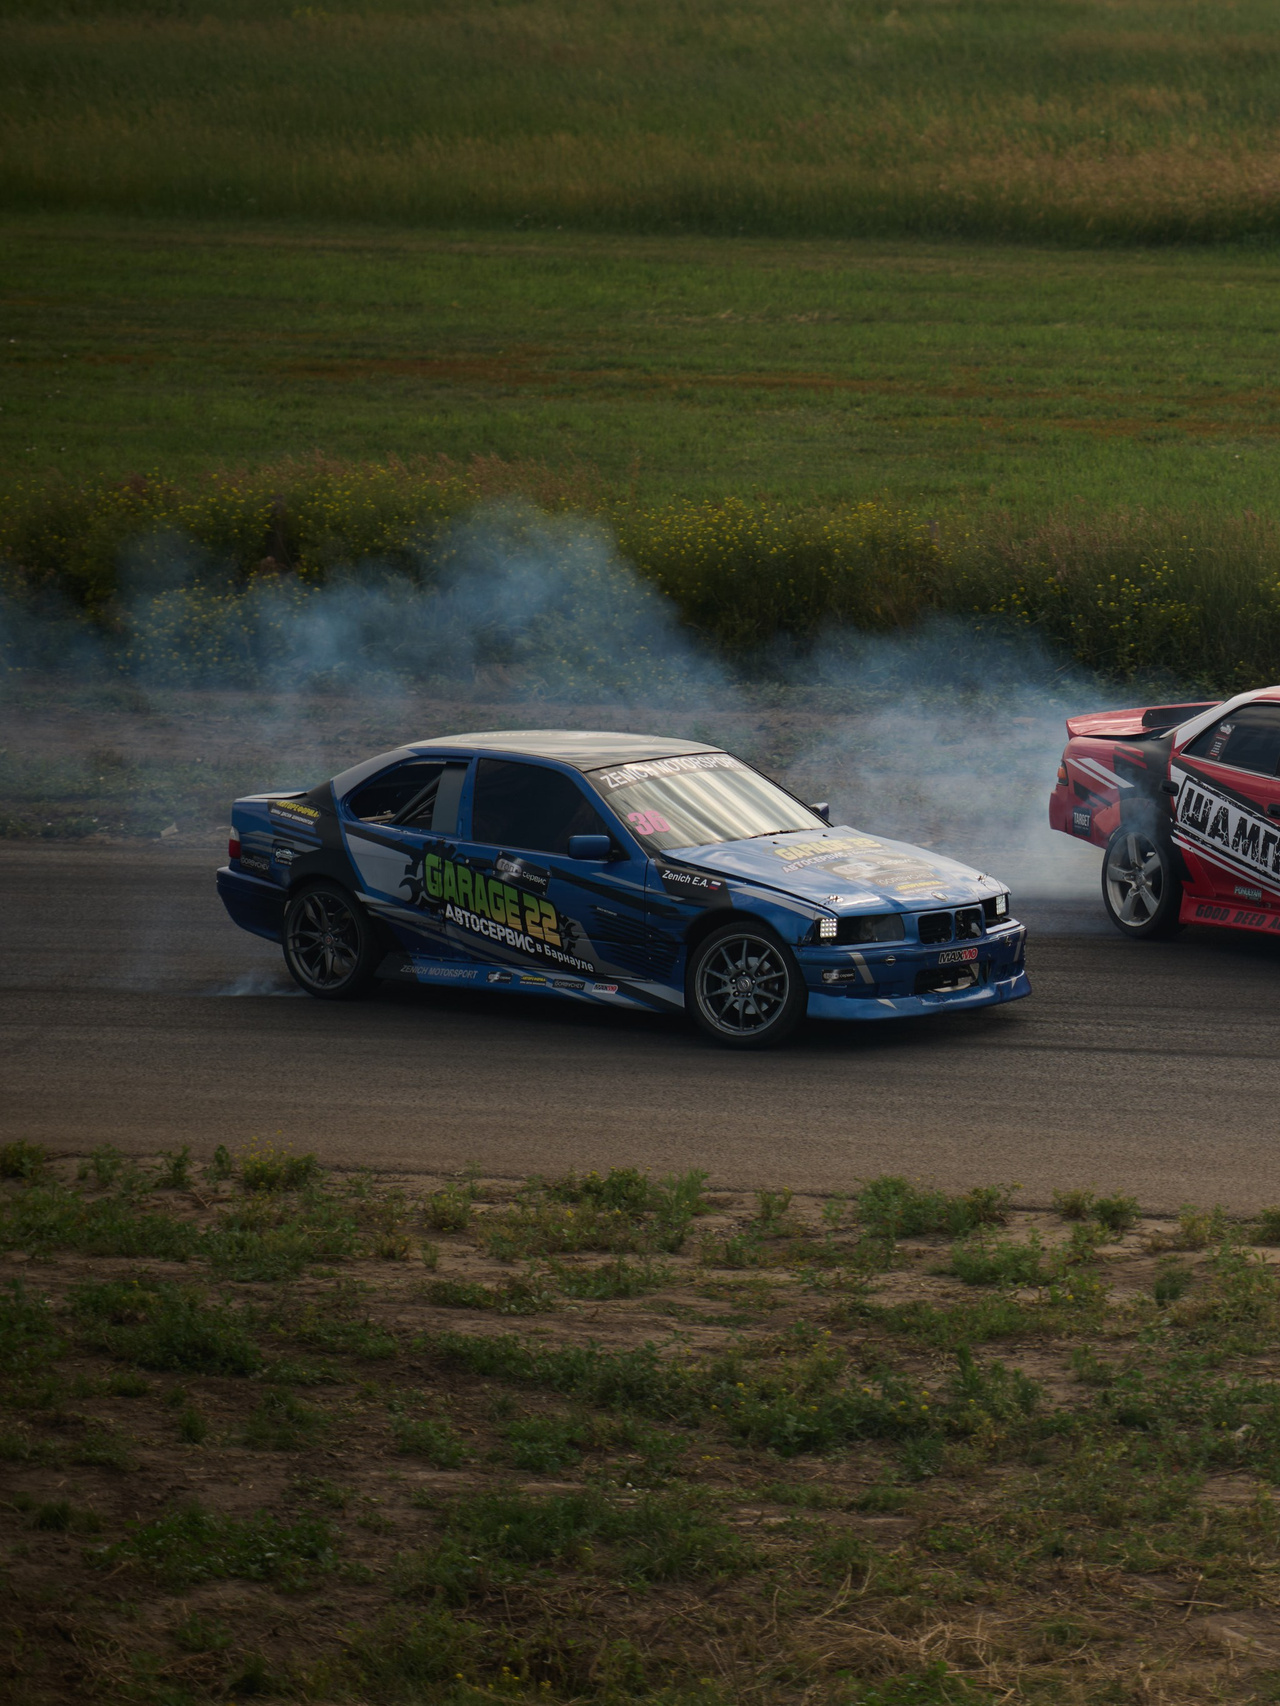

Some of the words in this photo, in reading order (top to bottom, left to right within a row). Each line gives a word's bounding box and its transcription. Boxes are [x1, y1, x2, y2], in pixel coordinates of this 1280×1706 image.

[600, 763, 655, 789] ZENICH
[653, 755, 742, 774] MOTORSPORT
[627, 810, 671, 836] 36
[774, 839, 853, 861] GARAGE
[662, 870, 691, 884] Zenich
[692, 876, 709, 888] E.A.
[424, 853, 523, 932] GARAGE
[522, 892, 562, 947] 22
[445, 903, 536, 954] АВТОСЕРВИС
[536, 942, 543, 953] в
[544, 944, 595, 973] Барнауле
[400, 964, 429, 976] ZENICH
[428, 967, 479, 980] MOTORSPORT
